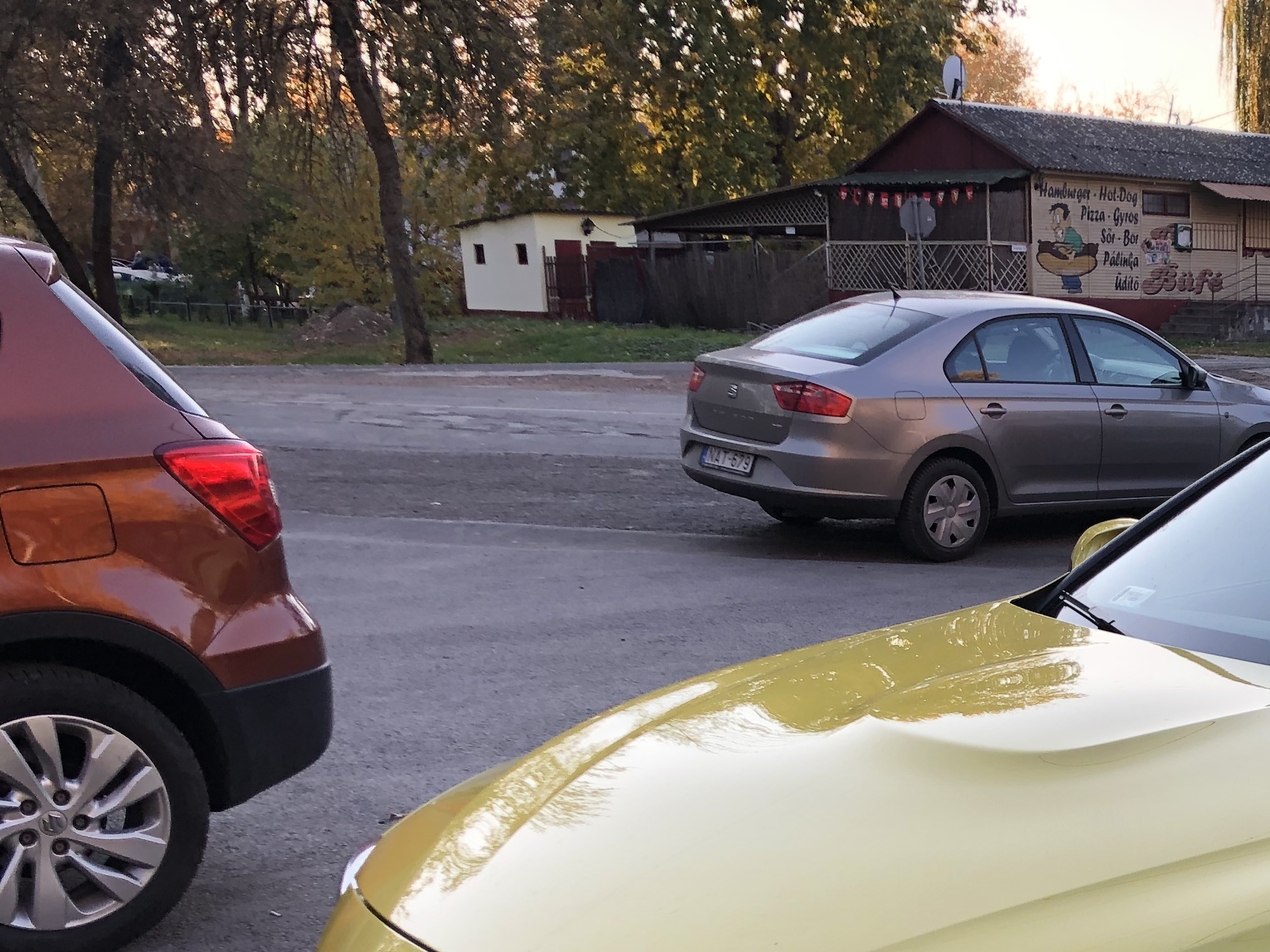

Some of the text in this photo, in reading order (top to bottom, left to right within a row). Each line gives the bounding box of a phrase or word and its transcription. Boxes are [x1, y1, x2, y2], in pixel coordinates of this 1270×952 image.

[1039, 182, 1138, 207] Hamburger Hot-Dog
[1080, 205, 1139, 226] Pizza Gyros
[1123, 229, 1139, 247] Bor
[1142, 263, 1224, 295] Büfé
